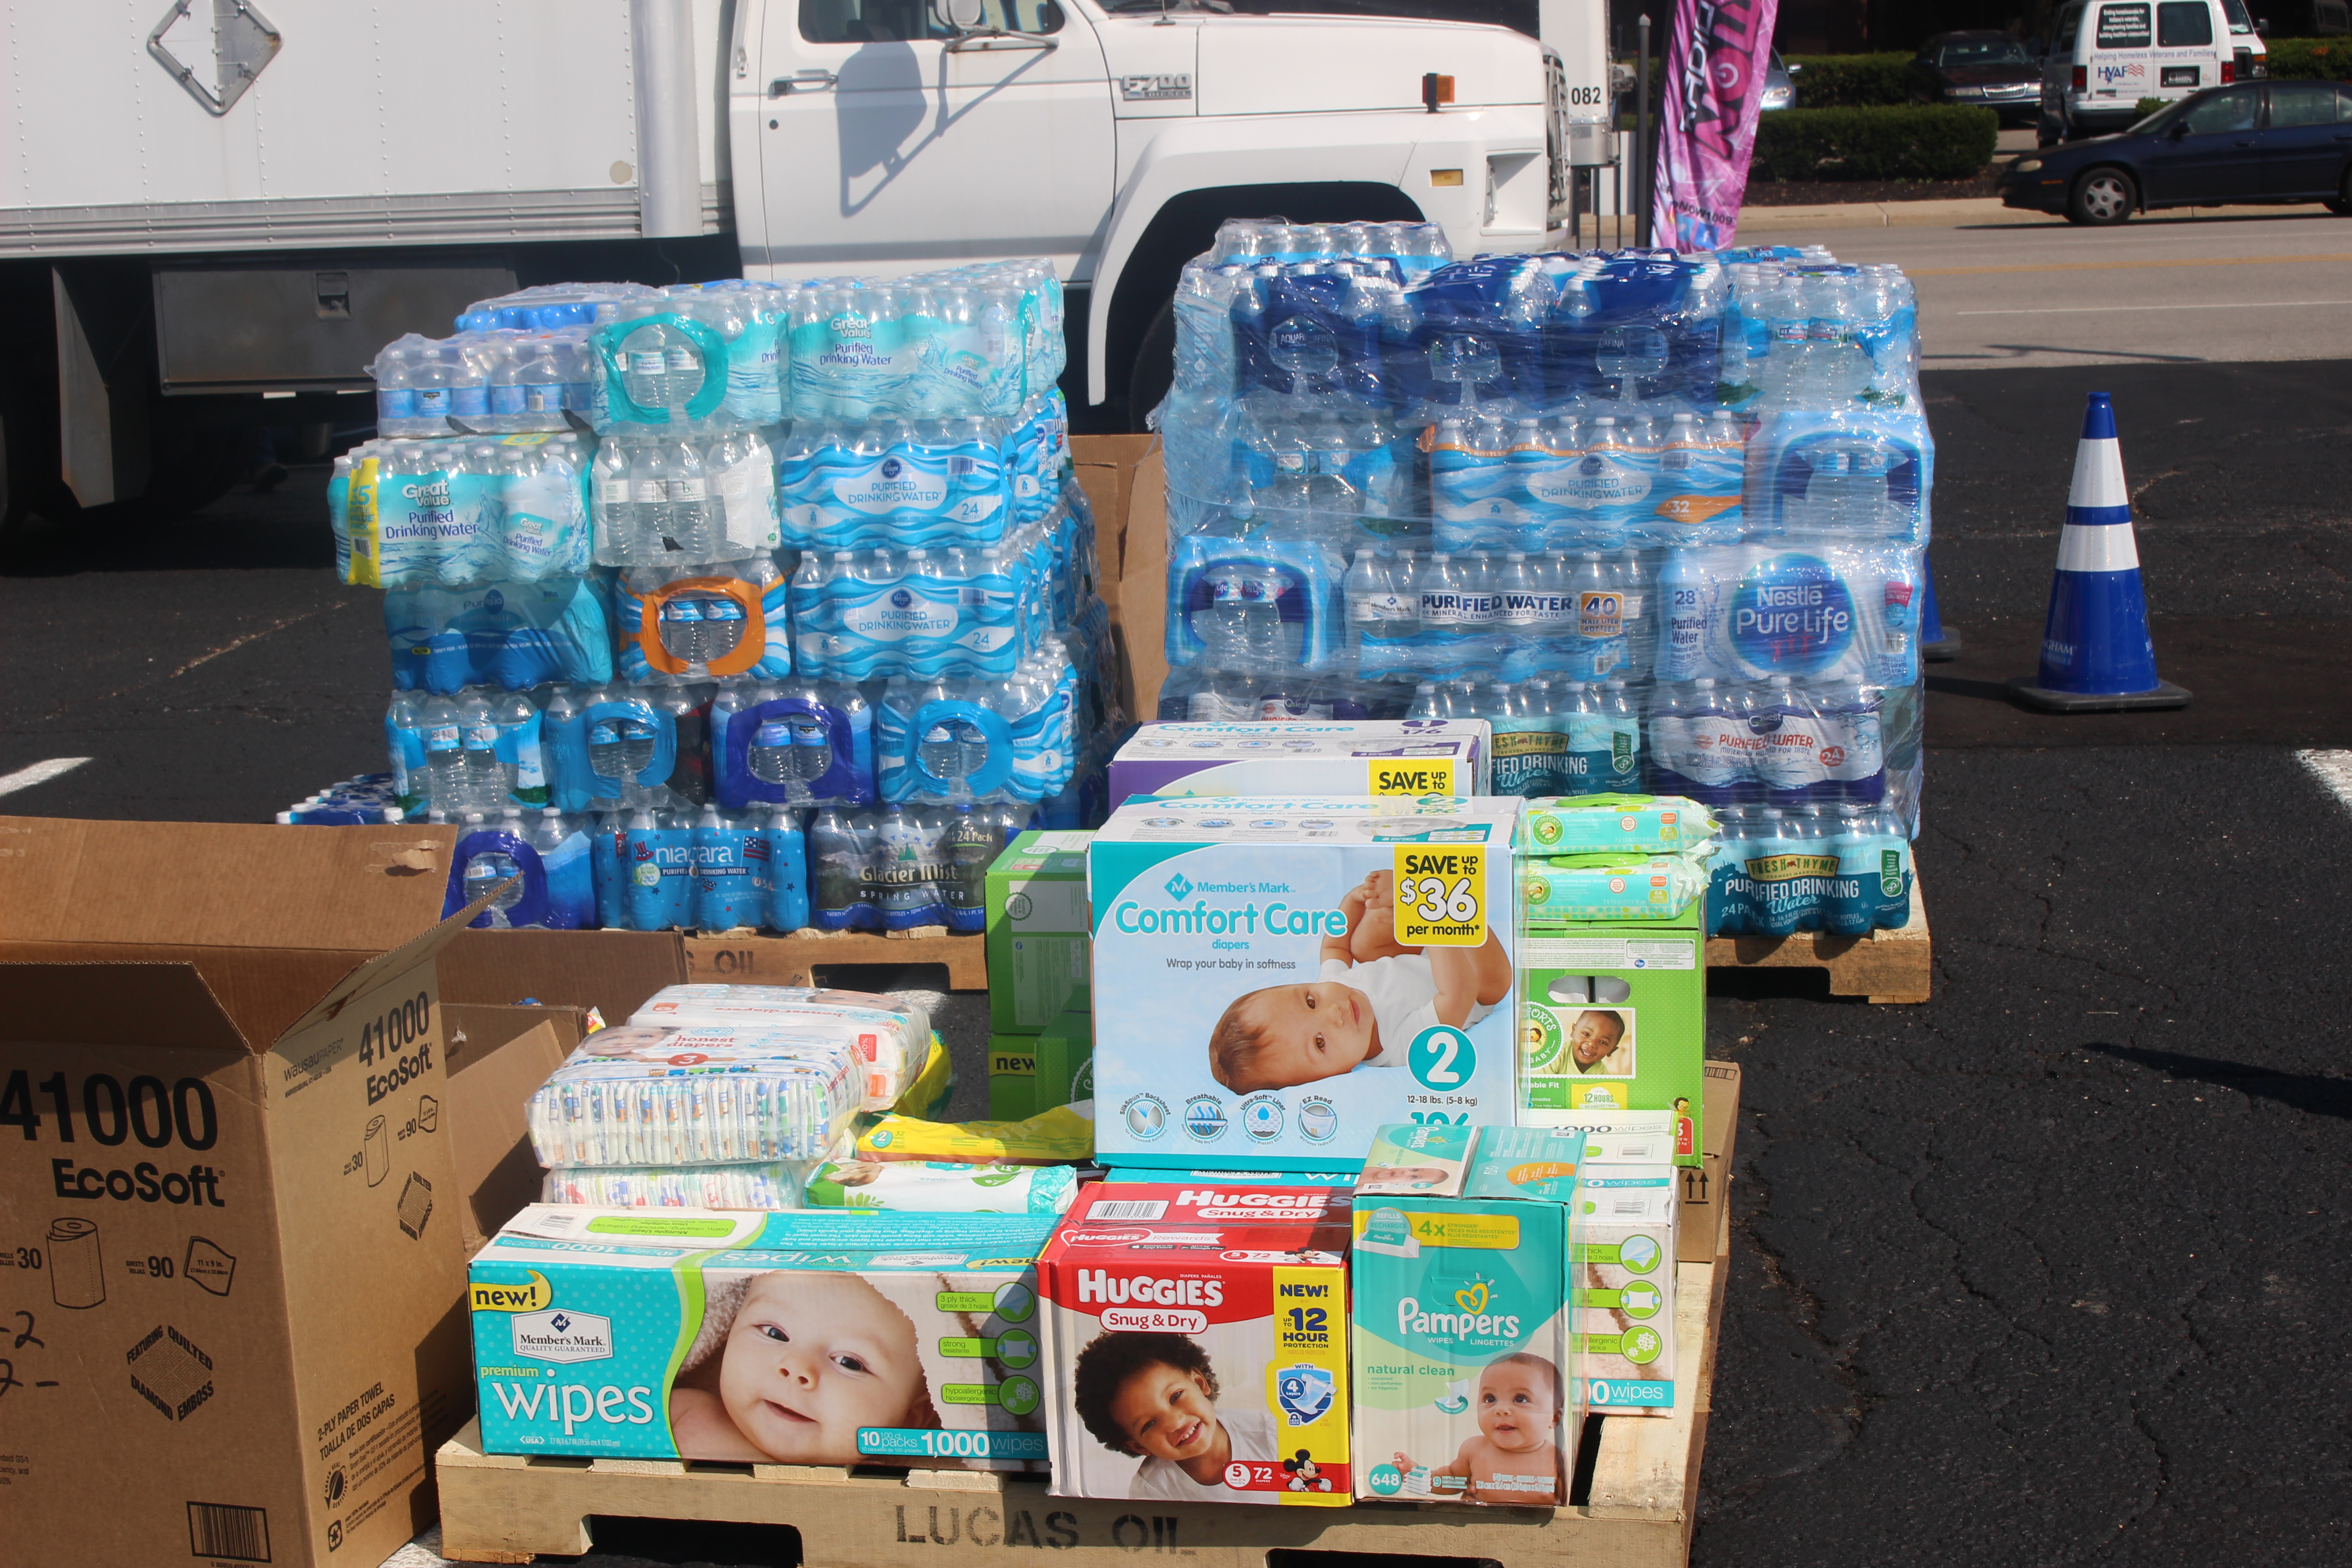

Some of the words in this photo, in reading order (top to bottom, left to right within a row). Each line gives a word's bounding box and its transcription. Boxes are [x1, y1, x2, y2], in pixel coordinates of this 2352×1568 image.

[2094, 53, 2117, 61] Helping
[2189, 49, 2214, 57] Families
[2098, 66, 2128, 78] HVAF
[1123, 74, 1192, 91] F700
[1571, 87, 1601, 105] 082
[831, 318, 870, 333] Great
[841, 328, 872, 339] Value
[835, 342, 873, 355] Purified
[820, 353, 859, 367] Drinking
[861, 353, 892, 366] Water
[402, 479, 450, 500] Great
[872, 481, 916, 492] PURIFIED
[1568, 478, 1619, 489] PURIFIED
[848, 493, 900, 504] DRINKING
[902, 491, 939, 501] WATER
[1542, 488, 1602, 499] DRINKING
[1603, 486, 1643, 499] WATER
[416, 495, 450, 508] Value
[961, 502, 980, 516] 24
[1670, 500, 1690, 514] 32
[408, 509, 454, 524] Purified
[386, 524, 438, 540] Drinking
[440, 523, 478, 537] Water
[503, 536, 531, 554] Drinking
[531, 544, 552, 557] Water
[515, 533, 544, 546] Purified
[1422, 595, 1502, 612] PURIFIED
[1504, 596, 1572, 611] WATER
[1674, 590, 1695, 605] 28
[1432, 609, 1467, 618] MINERAL
[1470, 610, 1513, 620] ENHANCED
[1533, 611, 1558, 620] TASTE
[1585, 597, 1618, 617] 40
[881, 611, 927, 622] PURIFIED
[1671, 617, 1707, 629] Purified
[859, 621, 910, 632] DRINKING
[911, 620, 951, 631] WATER
[1736, 608, 1798, 635] Pure
[1804, 607, 1848, 644] Life
[973, 632, 990, 646] 24
[1672, 630, 1698, 644] Water
[1528, 734, 1566, 749] THYME
[1719, 734, 1769, 750] PURIFIED
[1772, 734, 1814, 749] WATER
[1720, 747, 1753, 756] MINERALS
[1794, 747, 1811, 755] TASTE
[1492, 757, 1519, 775] FIED
[1522, 755, 1587, 775] DRINKING
[1379, 772, 1427, 789] SAVE
[1431, 772, 1446, 782] up
[1432, 779, 1445, 789] to
[957, 831, 970, 842] 24
[972, 831, 993, 843] Pack
[656, 845, 734, 865] niagara
[1461, 856, 1478, 868] up
[1405, 855, 1458, 875] SAVE
[1463, 863, 1476, 875] to
[1750, 860, 1786, 875] FRESH
[1796, 858, 1836, 872] THYME
[860, 864, 914, 883] Glacier
[920, 863, 957, 882] Mist
[860, 890, 910, 901] SPRING
[921, 889, 964, 900] WATER
[1197, 881, 1255, 894] Member's
[1725, 878, 1790, 902] PURIFIED
[1792, 878, 1859, 898] DRINKING
[1400, 877, 1478, 923] $36
[1766, 893, 1820, 915] Water
[1115, 899, 1259, 936] Comfort
[1263, 901, 1348, 937] Care
[1722, 904, 1736, 917] 24
[1738, 903, 1764, 927] PACK
[1406, 925, 1431, 938] per
[1211, 939, 1250, 952] diapers
[1166, 958, 1194, 971] Wrap
[1196, 960, 1217, 971] your
[1219, 958, 1243, 971] baby
[1245, 958, 1255, 969] in
[1257, 958, 1296, 970] softness
[358, 991, 430, 1068] 41000
[666, 1041, 733, 1049] diapers
[676, 1034, 739, 1044] honest
[996, 1057, 1035, 1071] new
[1426, 1031, 1460, 1083] 2
[366, 1044, 433, 1106] EcoSoft
[1406, 1095, 1429, 1105] 12-18
[1430, 1095, 1444, 1105] lbs.
[1446, 1095, 1463, 1107] (5-8
[1464, 1095, 1478, 1107] kg)
[1583, 1093, 1592, 1102] 12
[1593, 1093, 1614, 1103] HOURS
[0, 1069, 218, 1151] 41000
[51, 1158, 225, 1207] EcoSoft
[1175, 1190, 1352, 1208] HUGGIES
[1418, 1220, 1446, 1237] 4x
[17, 1247, 42, 1269] 30
[148, 1255, 175, 1279] 90
[1078, 1268, 1224, 1307] HUGGIES
[1280, 1284, 1329, 1297] NEW!
[475, 1286, 537, 1307] new!
[1109, 1313, 1150, 1330] Snug
[1155, 1313, 1166, 1326] &
[1167, 1314, 1198, 1330] Dry
[1289, 1307, 1328, 1332] 12
[1397, 1296, 1520, 1342] Pampers
[520, 1334, 571, 1346] Member's
[1283, 1332, 1328, 1342] HOUR
[126, 1324, 163, 1366] FEATURING
[167, 1325, 213, 1371] QUILTED
[943, 1341, 965, 1349] strong
[480, 1364, 539, 1379] premium
[1367, 1363, 1414, 1375] natural
[1418, 1364, 1455, 1377] clean
[130, 1373, 173, 1421] DIAMOND
[177, 1380, 214, 1422] EMBOSS
[945, 1387, 996, 1396] hypoallergenic
[1611, 1381, 1664, 1400] wipes
[491, 1367, 654, 1436] wipes
[318, 1420, 336, 1442] 2-PLY
[337, 1399, 359, 1426] PAPER
[360, 1382, 384, 1407] TOWEL
[319, 1431, 346, 1461] TOALLA
[346, 1424, 356, 1437] DE
[357, 1412, 371, 1431] DOS
[372, 1393, 395, 1420] CAPAS
[860, 1431, 880, 1446] 10
[882, 1436, 917, 1449] packs
[921, 1431, 990, 1458] 1,000
[991, 1436, 1043, 1454] wipes
[1254, 1467, 1273, 1480] 72
[1371, 1473, 1400, 1486] 648
[896, 1504, 1080, 1550] LUCAS
